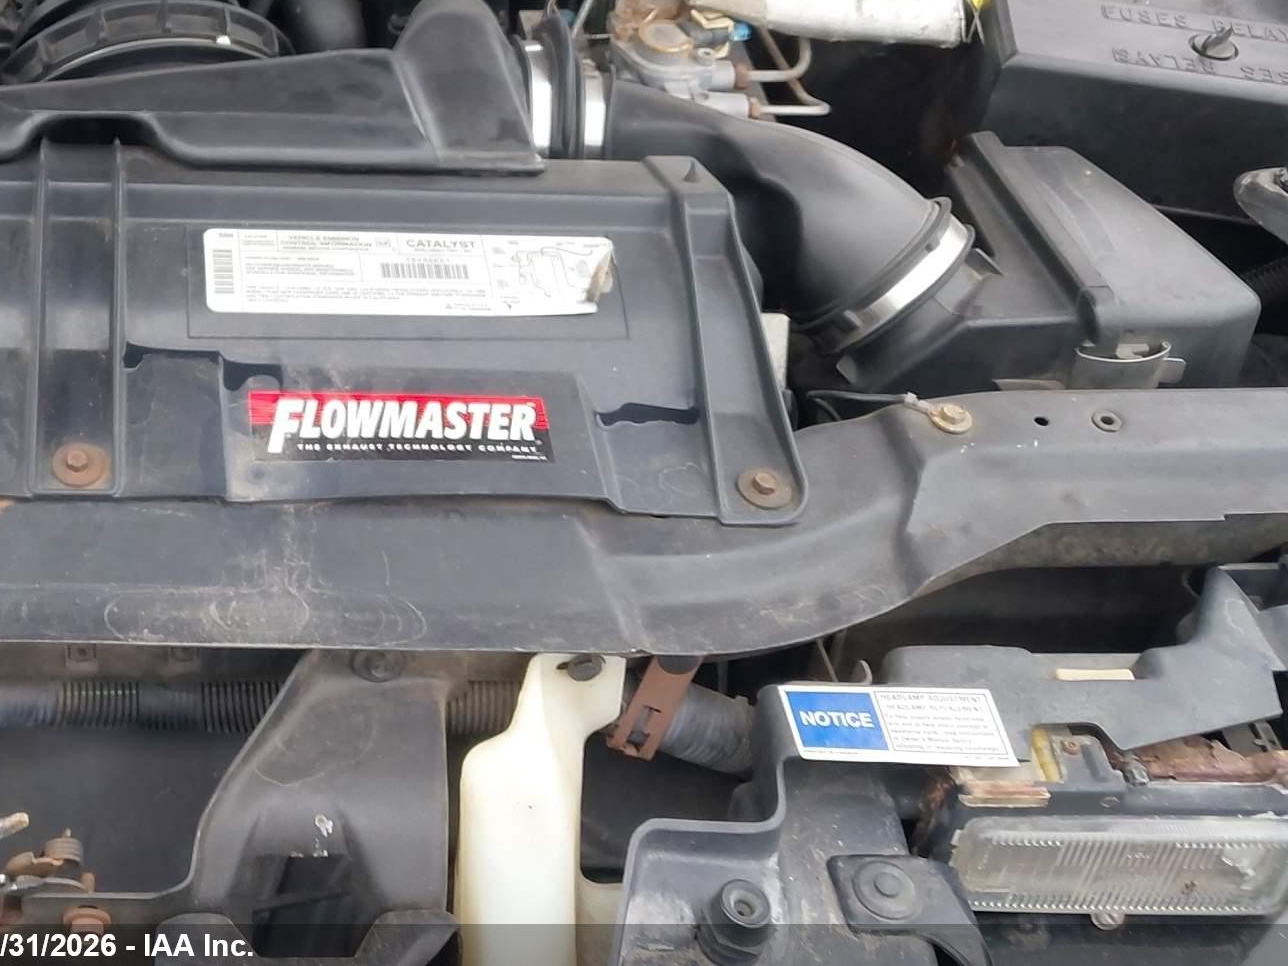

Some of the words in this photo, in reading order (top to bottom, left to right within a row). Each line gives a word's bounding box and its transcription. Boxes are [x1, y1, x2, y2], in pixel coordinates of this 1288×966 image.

[1101, 5, 1187, 28] FUSES
[406, 239, 476, 249] CATALYST
[267, 398, 538, 454] FLOWMASTER
[296, 443, 321, 451] THE
[326, 443, 383, 451] EXHAUST
[388, 444, 472, 452] TECHNOLOGY
[478, 444, 538, 453] COMPANY
[799, 710, 875, 728] NOTICE
